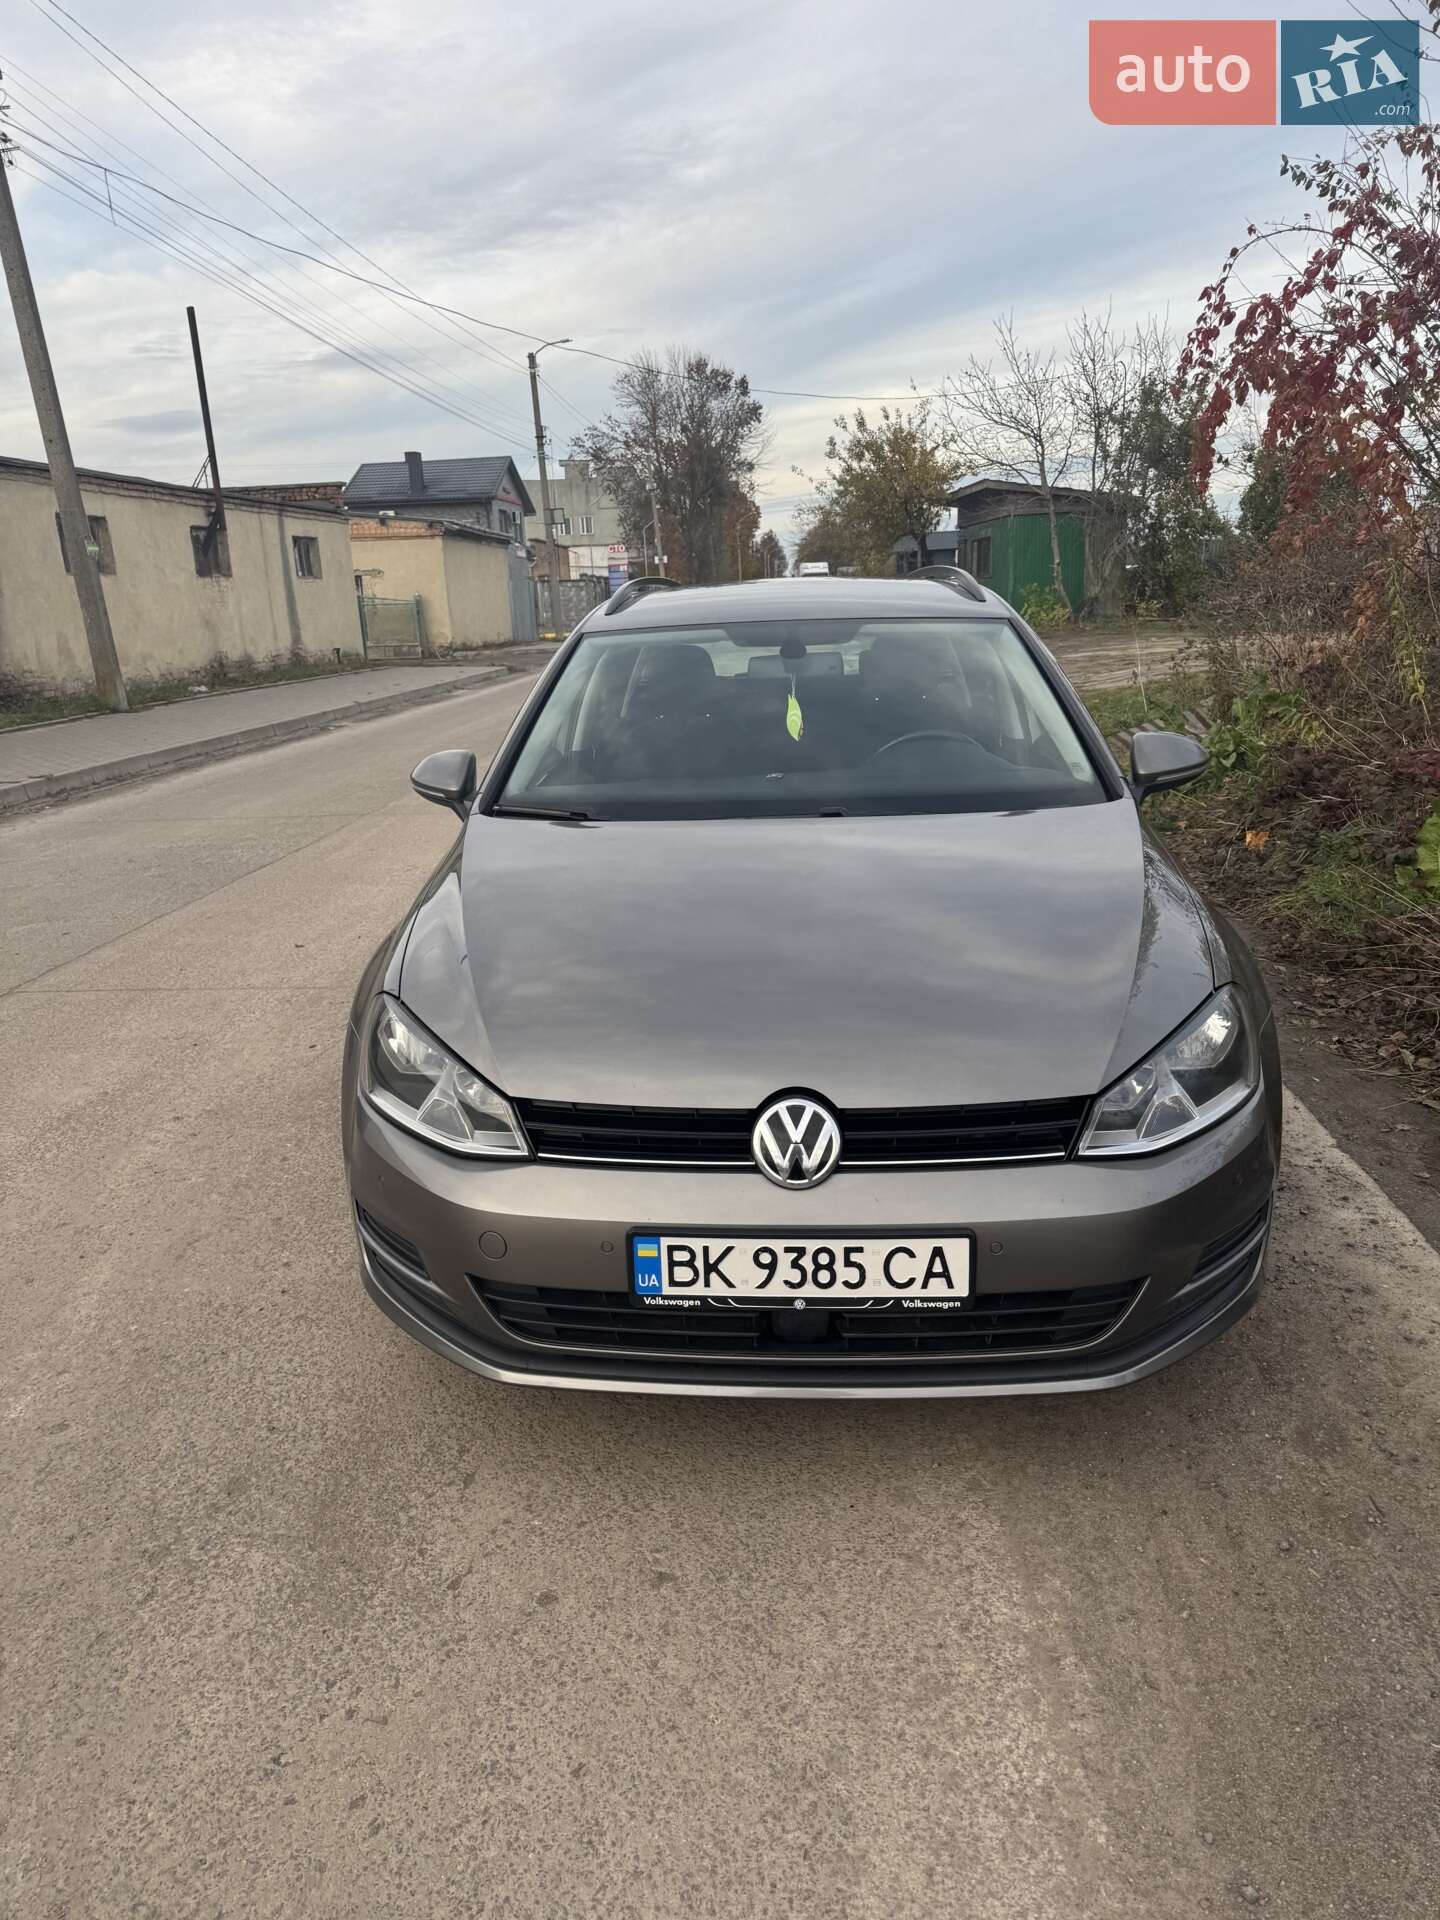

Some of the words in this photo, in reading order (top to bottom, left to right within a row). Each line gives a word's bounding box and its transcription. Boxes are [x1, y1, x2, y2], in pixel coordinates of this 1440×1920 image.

[666, 1244, 737, 1289] BK
[753, 1246, 867, 1289] 9385
[883, 1246, 955, 1290] CA
[638, 1274, 659, 1287] UA
[643, 1296, 701, 1308] Volkswagen
[901, 1299, 961, 1310] Volkswagen
